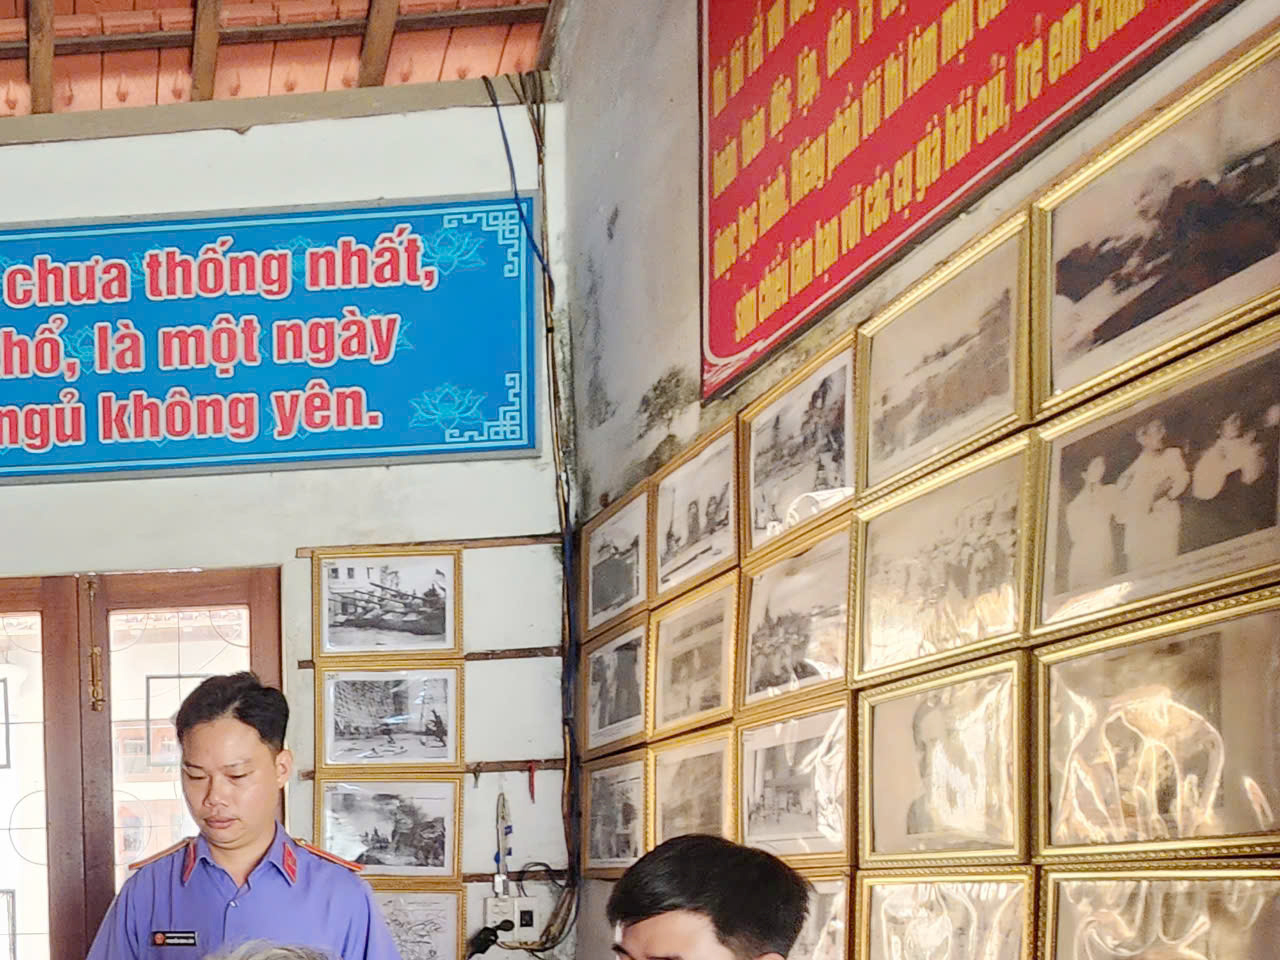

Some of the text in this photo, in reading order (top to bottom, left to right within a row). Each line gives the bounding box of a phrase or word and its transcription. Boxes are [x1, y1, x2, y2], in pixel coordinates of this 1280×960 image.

[864, 165, 890, 237] các
[893, 151, 913, 219] cụ
[915, 114, 941, 202] già
[945, 85, 972, 171] hái
[976, 53, 1010, 144] củi,
[1015, 13, 1043, 112] trẻ
[1048, 2, 1081, 85] em
[4, 256, 130, 307] chưa
[143, 237, 291, 299] thống
[306, 225, 437, 290] nhất,
[95, 321, 143, 373] là
[160, 315, 259, 377] một
[274, 307, 399, 366] ngày
[99, 389, 257, 442] không
[272, 379, 381, 439] yên.
